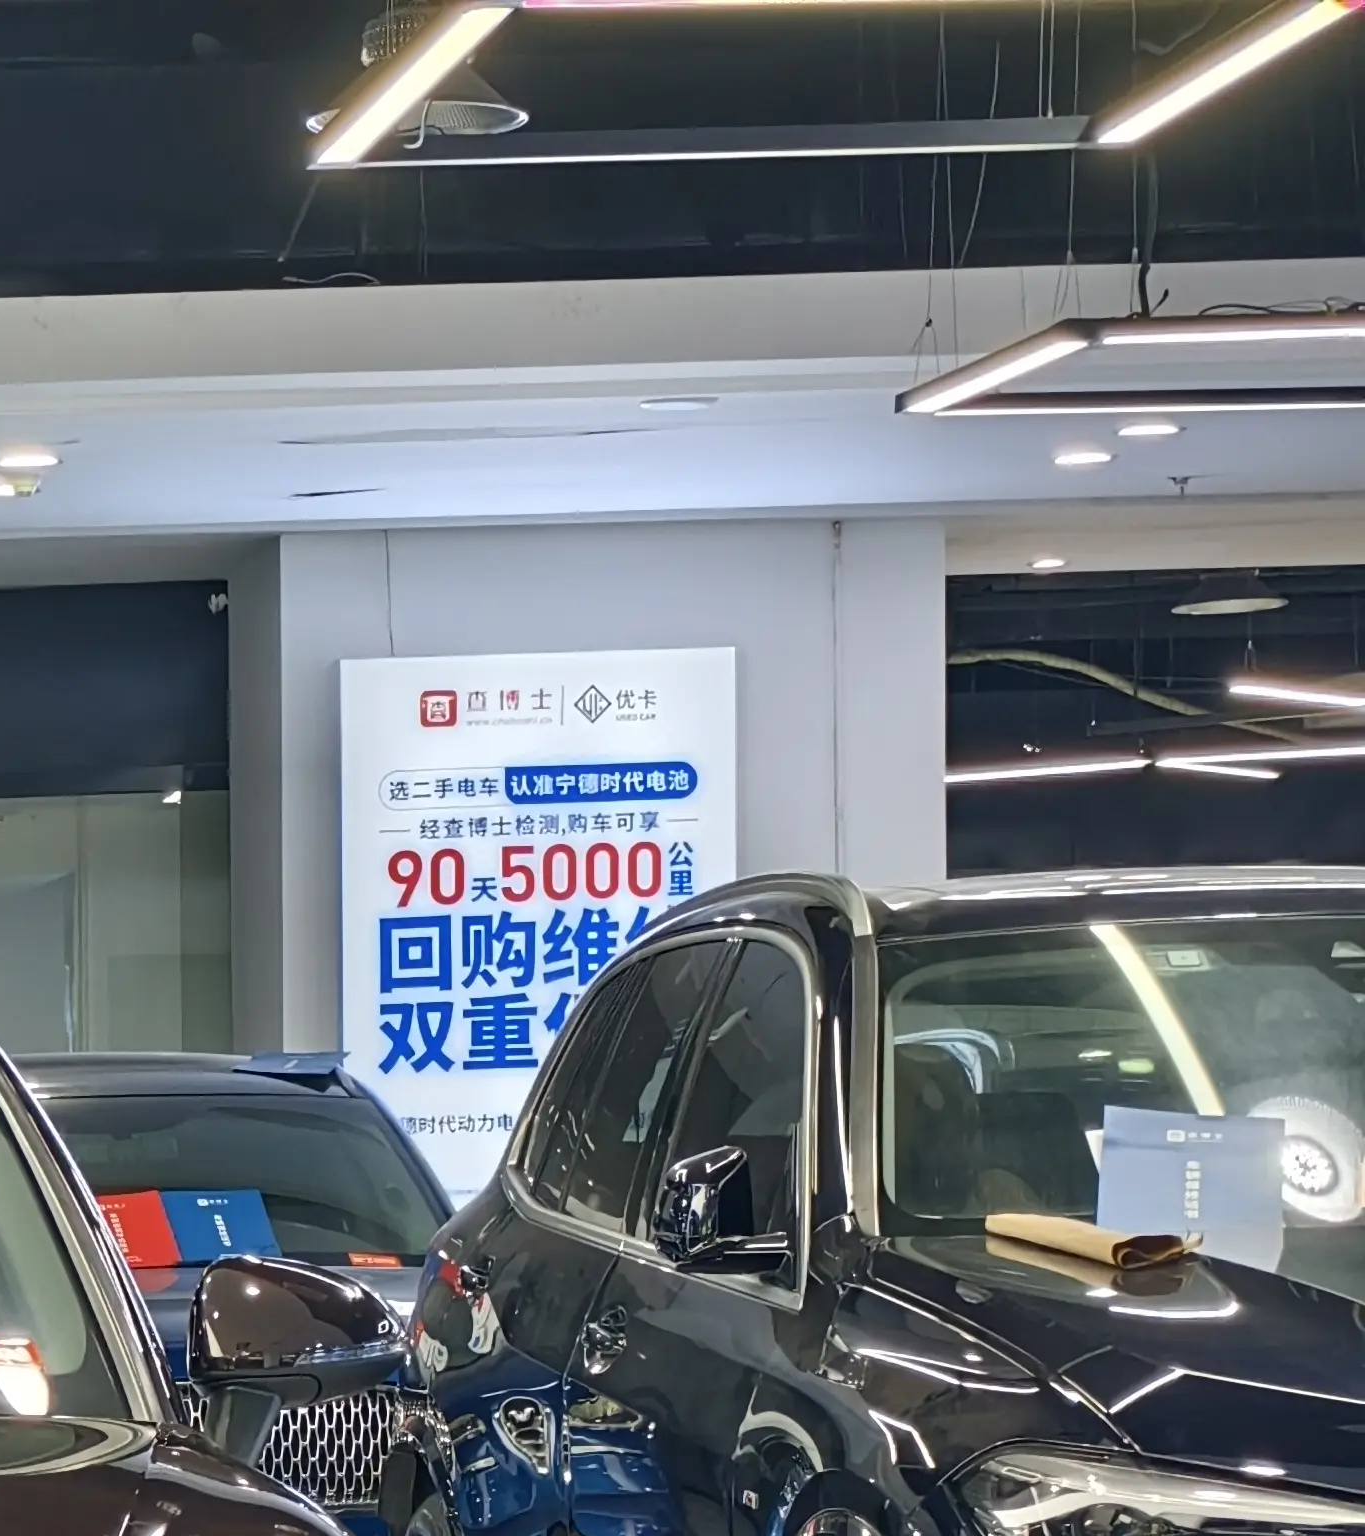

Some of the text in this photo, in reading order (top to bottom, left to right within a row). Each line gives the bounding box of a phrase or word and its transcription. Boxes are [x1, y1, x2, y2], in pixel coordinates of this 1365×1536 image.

[615, 688, 658, 710] 优卡
[389, 770, 690, 801] 选二手电车 认准宁德时代电池
[379, 905, 650, 994] 回购维
[379, 992, 572, 1074] 双重
